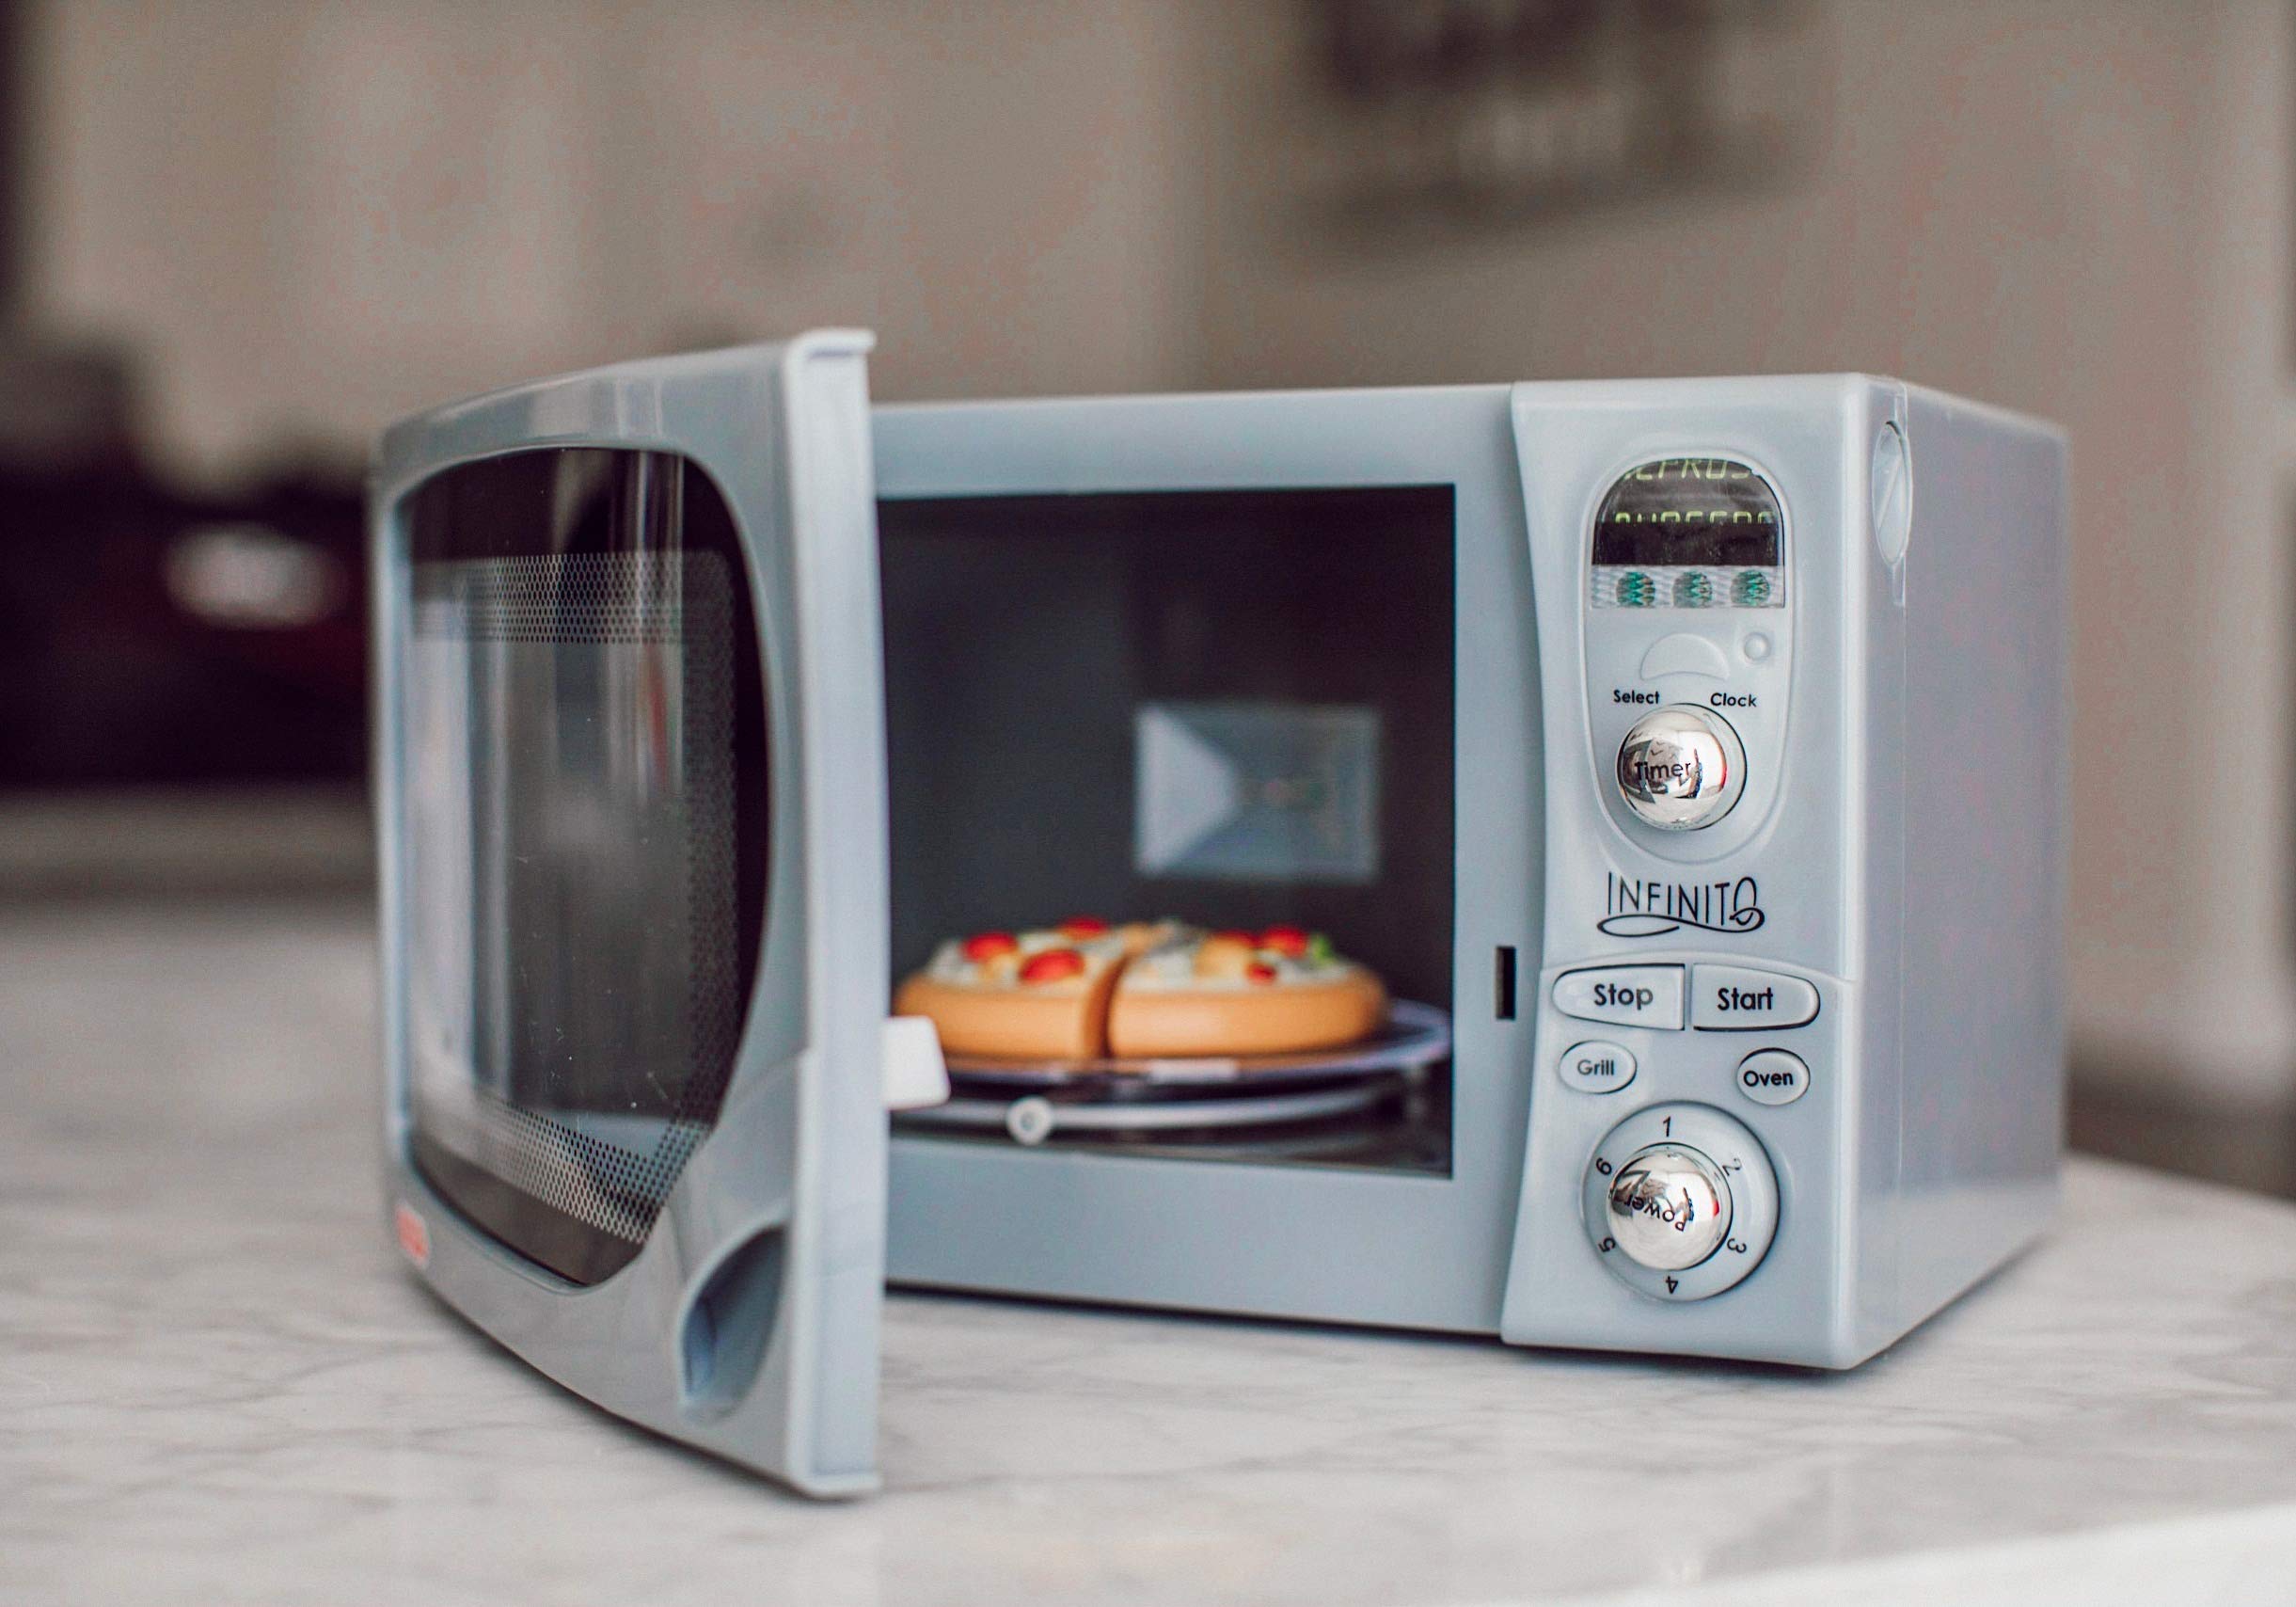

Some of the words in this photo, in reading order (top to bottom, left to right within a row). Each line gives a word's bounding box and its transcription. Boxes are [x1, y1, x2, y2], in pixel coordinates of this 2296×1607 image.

[1613, 690, 1660, 704] Select
[1710, 692, 1757, 707] Clock
[1634, 760, 1690, 781] Timer
[1592, 983, 1654, 1010] Stop
[1717, 987, 1774, 1010] Start
[1576, 1059, 1615, 1076] Grill
[1743, 1069, 1795, 1088] Oven
[1662, 1116, 1671, 1138] 1
[1721, 1157, 1743, 1176] 2
[1623, 1193, 1687, 1233] Power
[1598, 1236, 1617, 1253] 5
[1726, 1237, 1747, 1254] 3
[1665, 1275, 1679, 1295] 4
